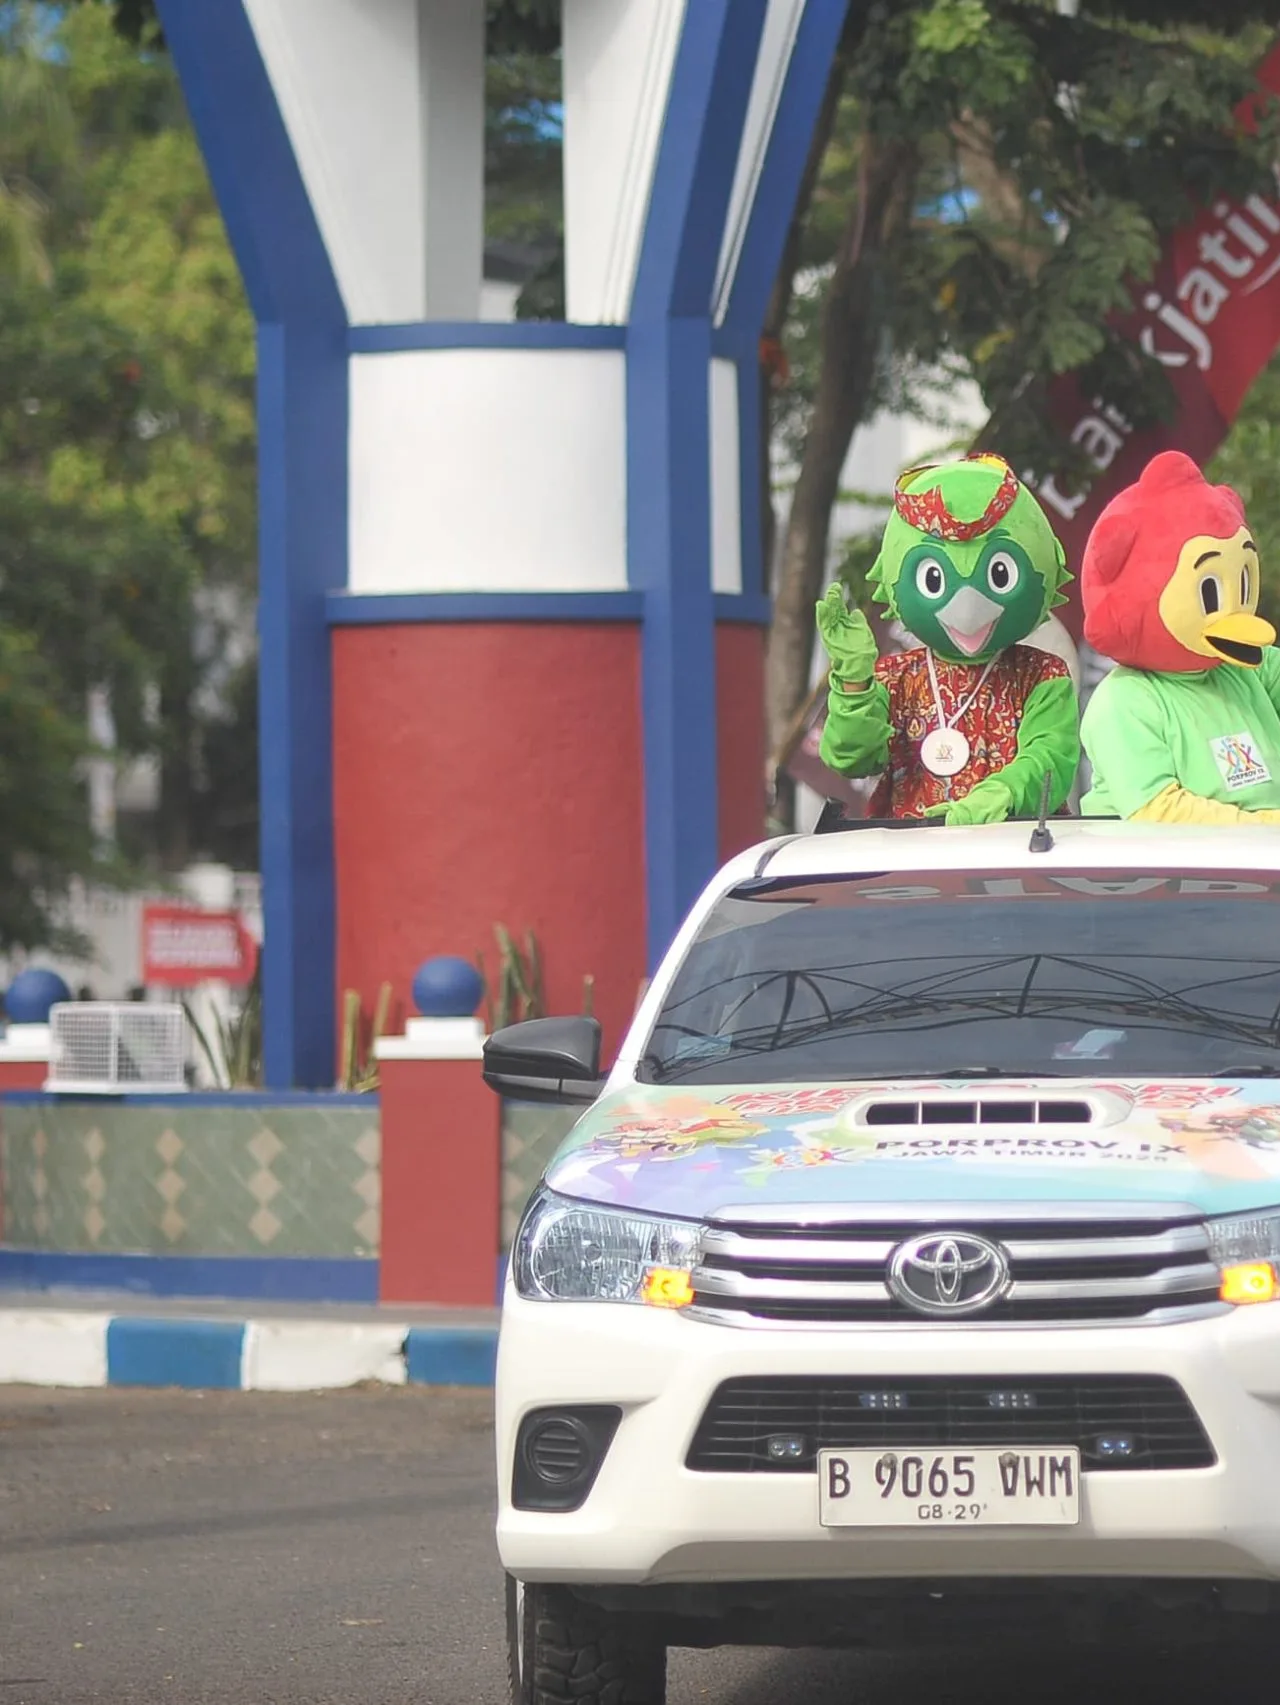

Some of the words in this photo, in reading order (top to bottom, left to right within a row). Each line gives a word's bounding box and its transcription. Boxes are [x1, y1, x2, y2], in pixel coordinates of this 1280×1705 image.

[876, 1138, 1119, 1151] PORPROV
[1138, 1143, 1187, 1154] IX
[895, 1150, 978, 1158] JAWA
[991, 1150, 1087, 1158] TIMUR
[828, 1456, 851, 1499] B
[874, 1455, 975, 1499] 9065
[998, 1454, 1074, 1498] VWM
